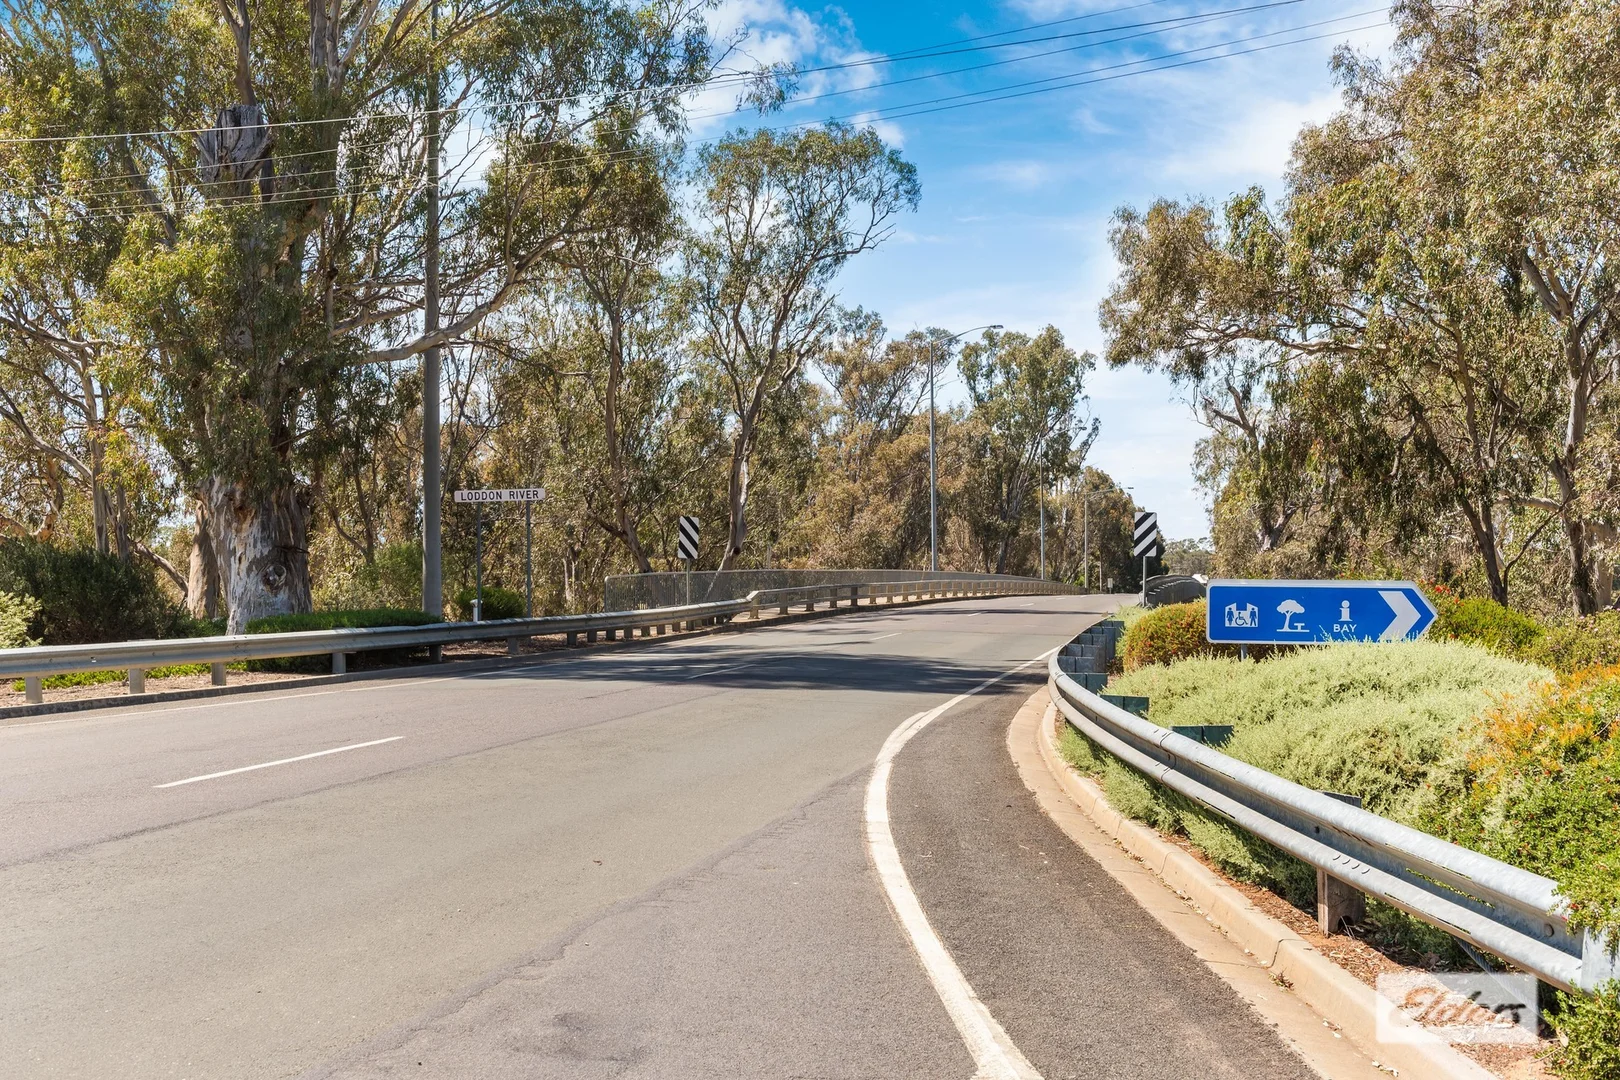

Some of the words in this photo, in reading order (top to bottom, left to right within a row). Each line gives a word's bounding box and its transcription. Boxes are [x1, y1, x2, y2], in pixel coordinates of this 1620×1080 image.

[460, 490, 503, 501] LODDON
[509, 489, 539, 499] RIVER
[1333, 624, 1357, 633] BAY
